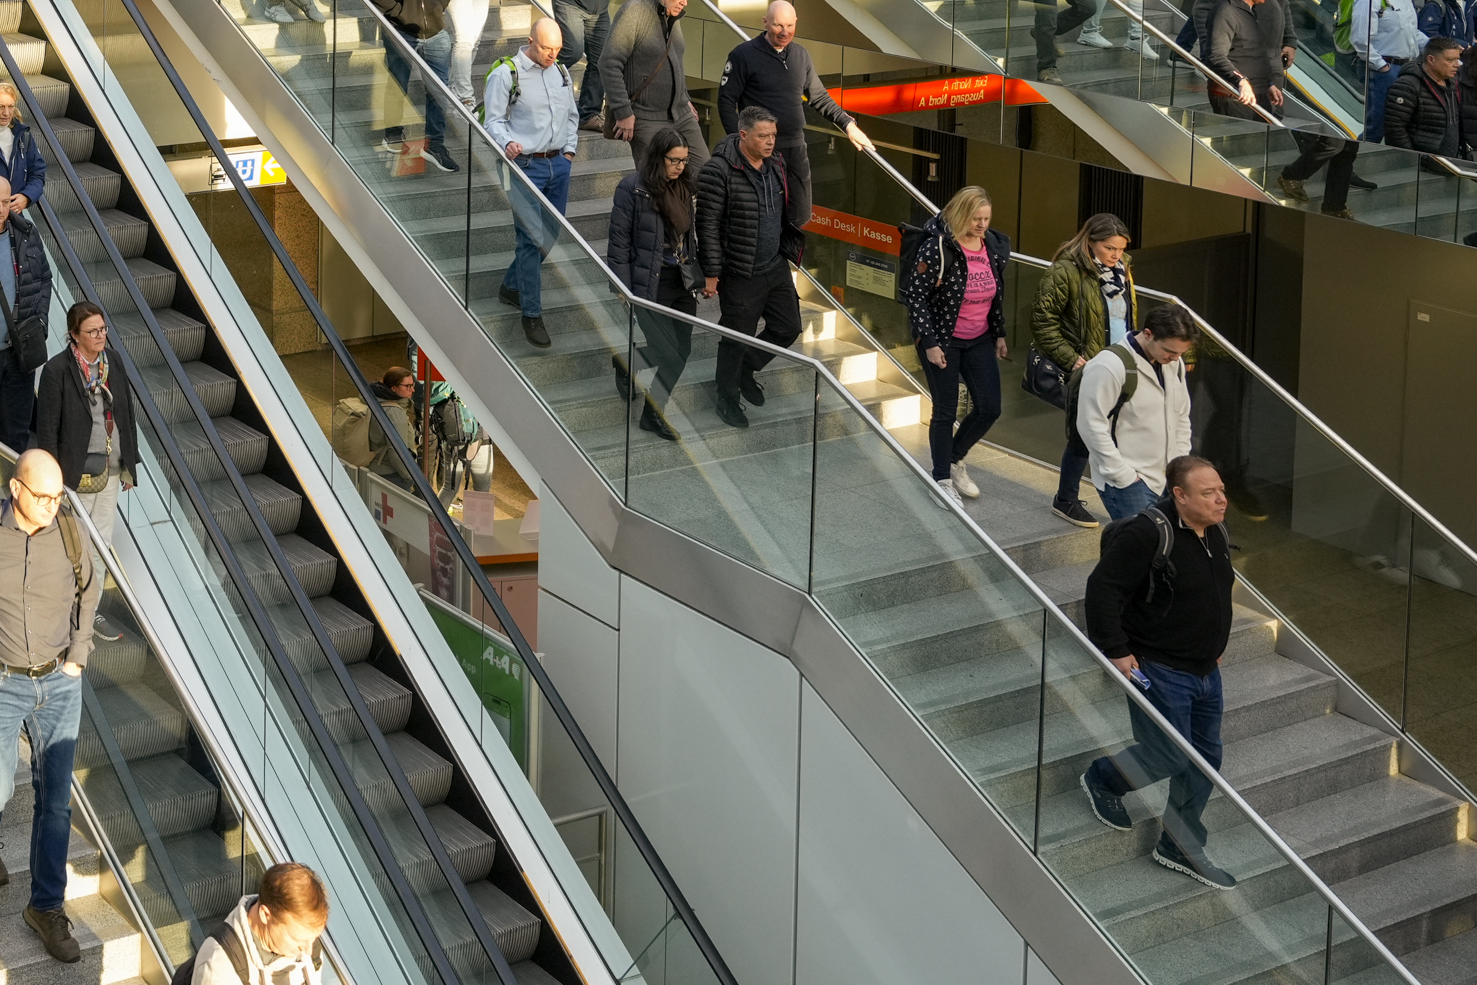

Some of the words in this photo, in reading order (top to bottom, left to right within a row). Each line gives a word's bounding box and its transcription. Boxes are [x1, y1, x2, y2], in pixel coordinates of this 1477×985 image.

[810, 212, 832, 227] Cash
[833, 219, 856, 233] Desk
[863, 227, 893, 244] Kasse
